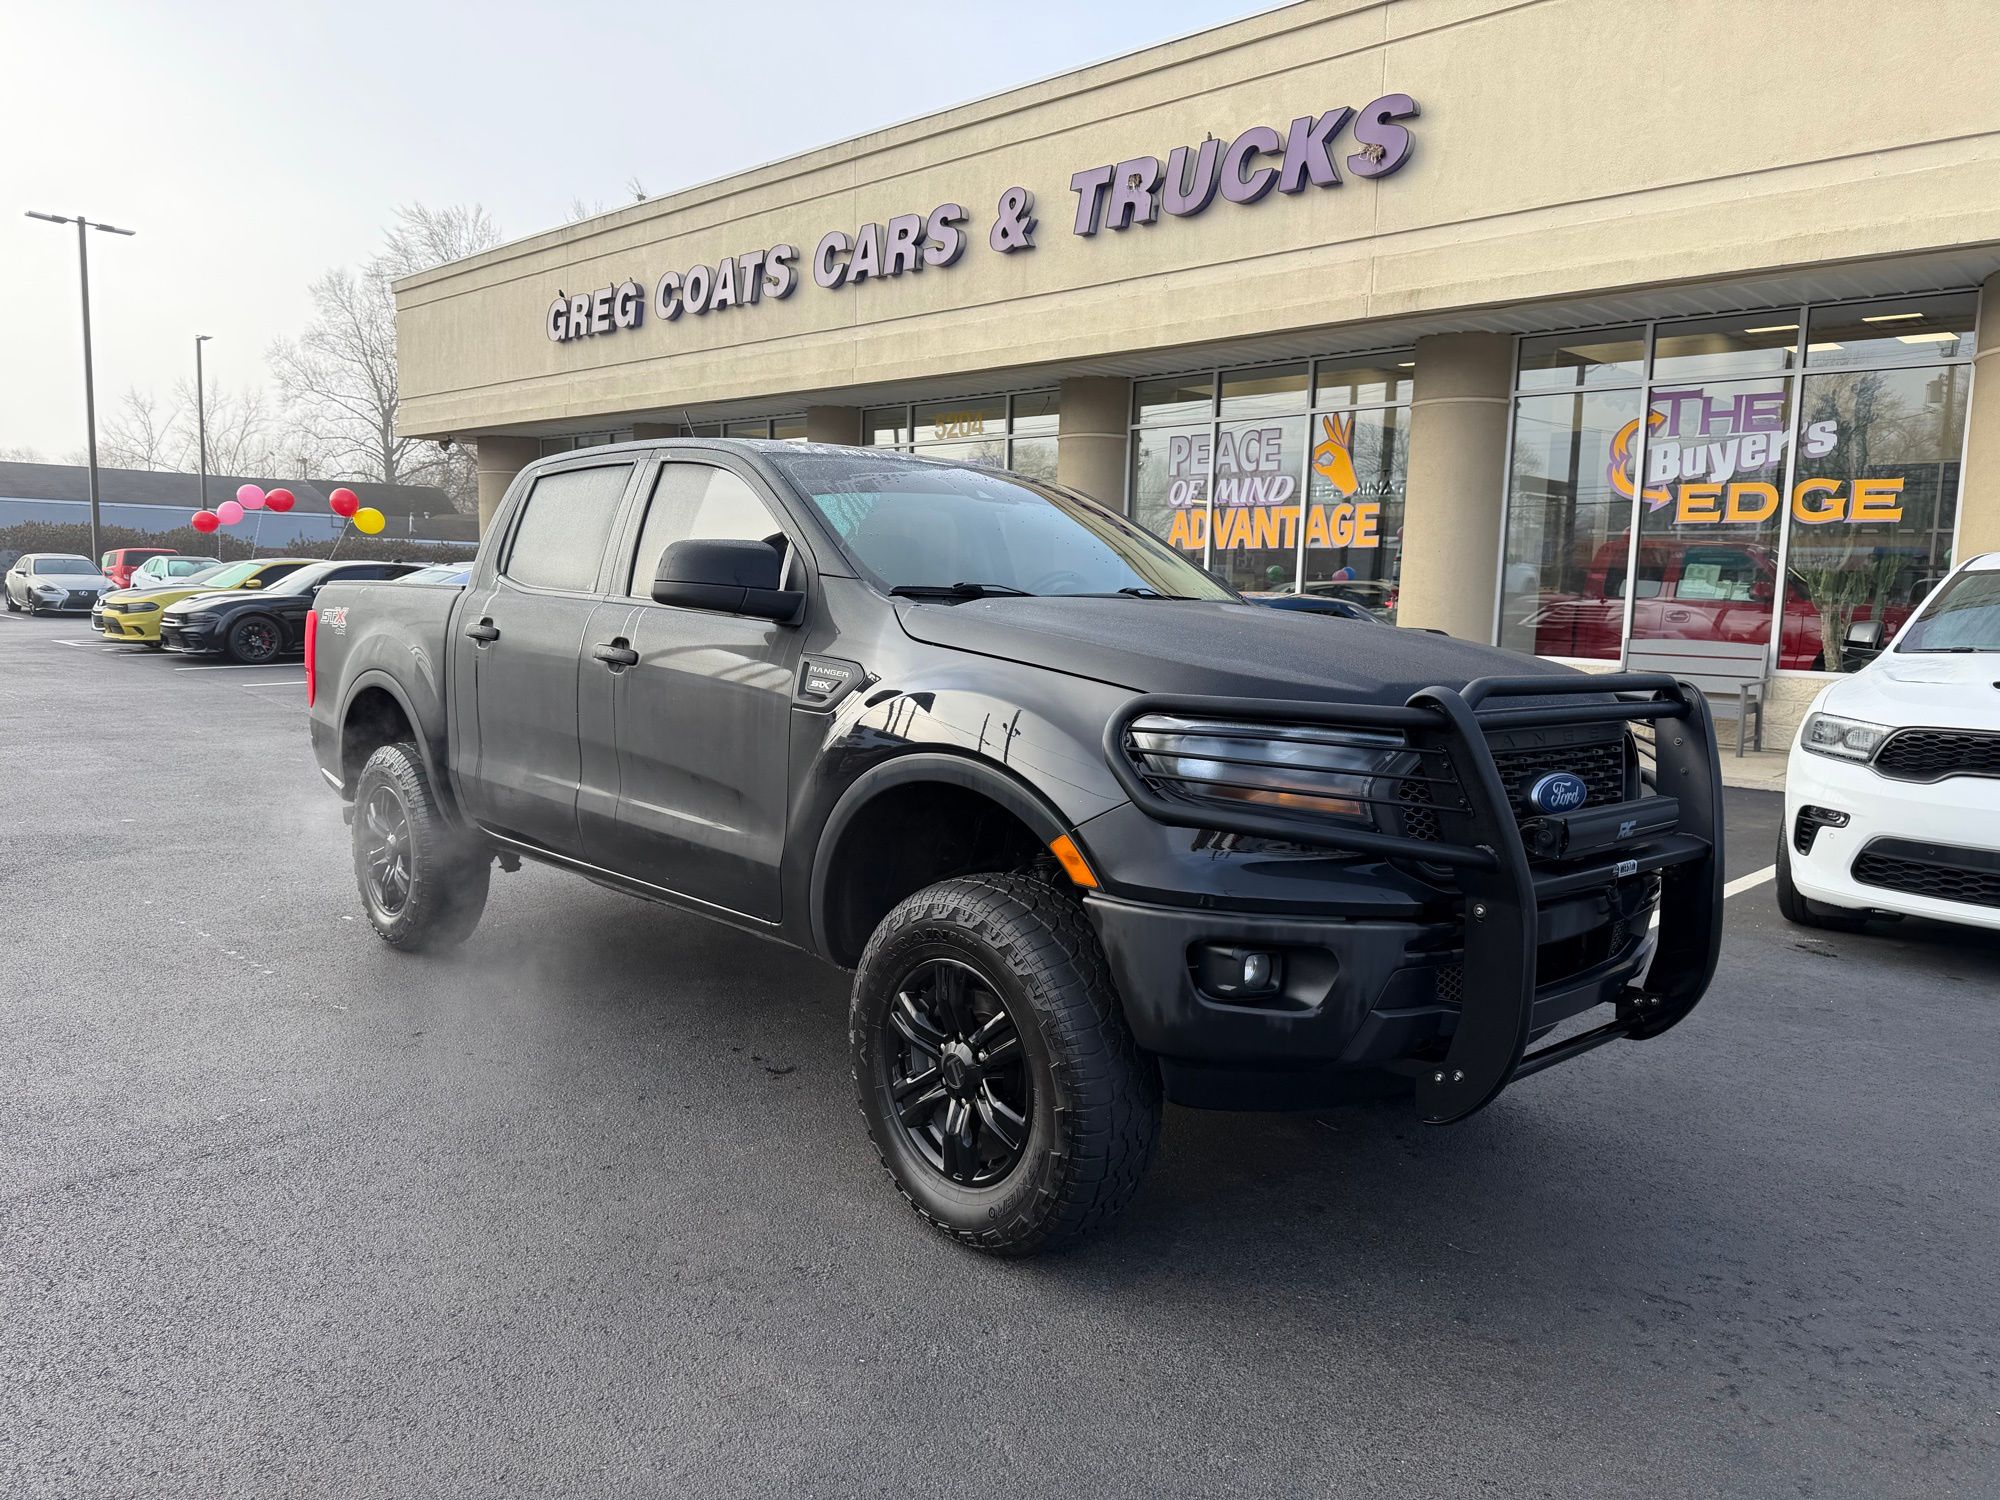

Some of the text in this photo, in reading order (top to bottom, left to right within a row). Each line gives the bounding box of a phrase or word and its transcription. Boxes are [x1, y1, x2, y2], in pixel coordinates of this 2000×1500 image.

[546, 93, 1421, 343] GREG COATS CARS & TRUCKS
[1650, 387, 1785, 438] THE
[1169, 427, 1282, 476] PEACE
[1168, 479, 1207, 508] OF
[1213, 475, 1296, 508] MIND
[1673, 476, 1905, 524] EDGE
[1168, 502, 1381, 550] ADVANTAGE
[320, 607, 349, 628] STX
[809, 665, 850, 678] RANGER
[810, 679, 832, 690] STX
[1550, 781, 1580, 807] Ford
